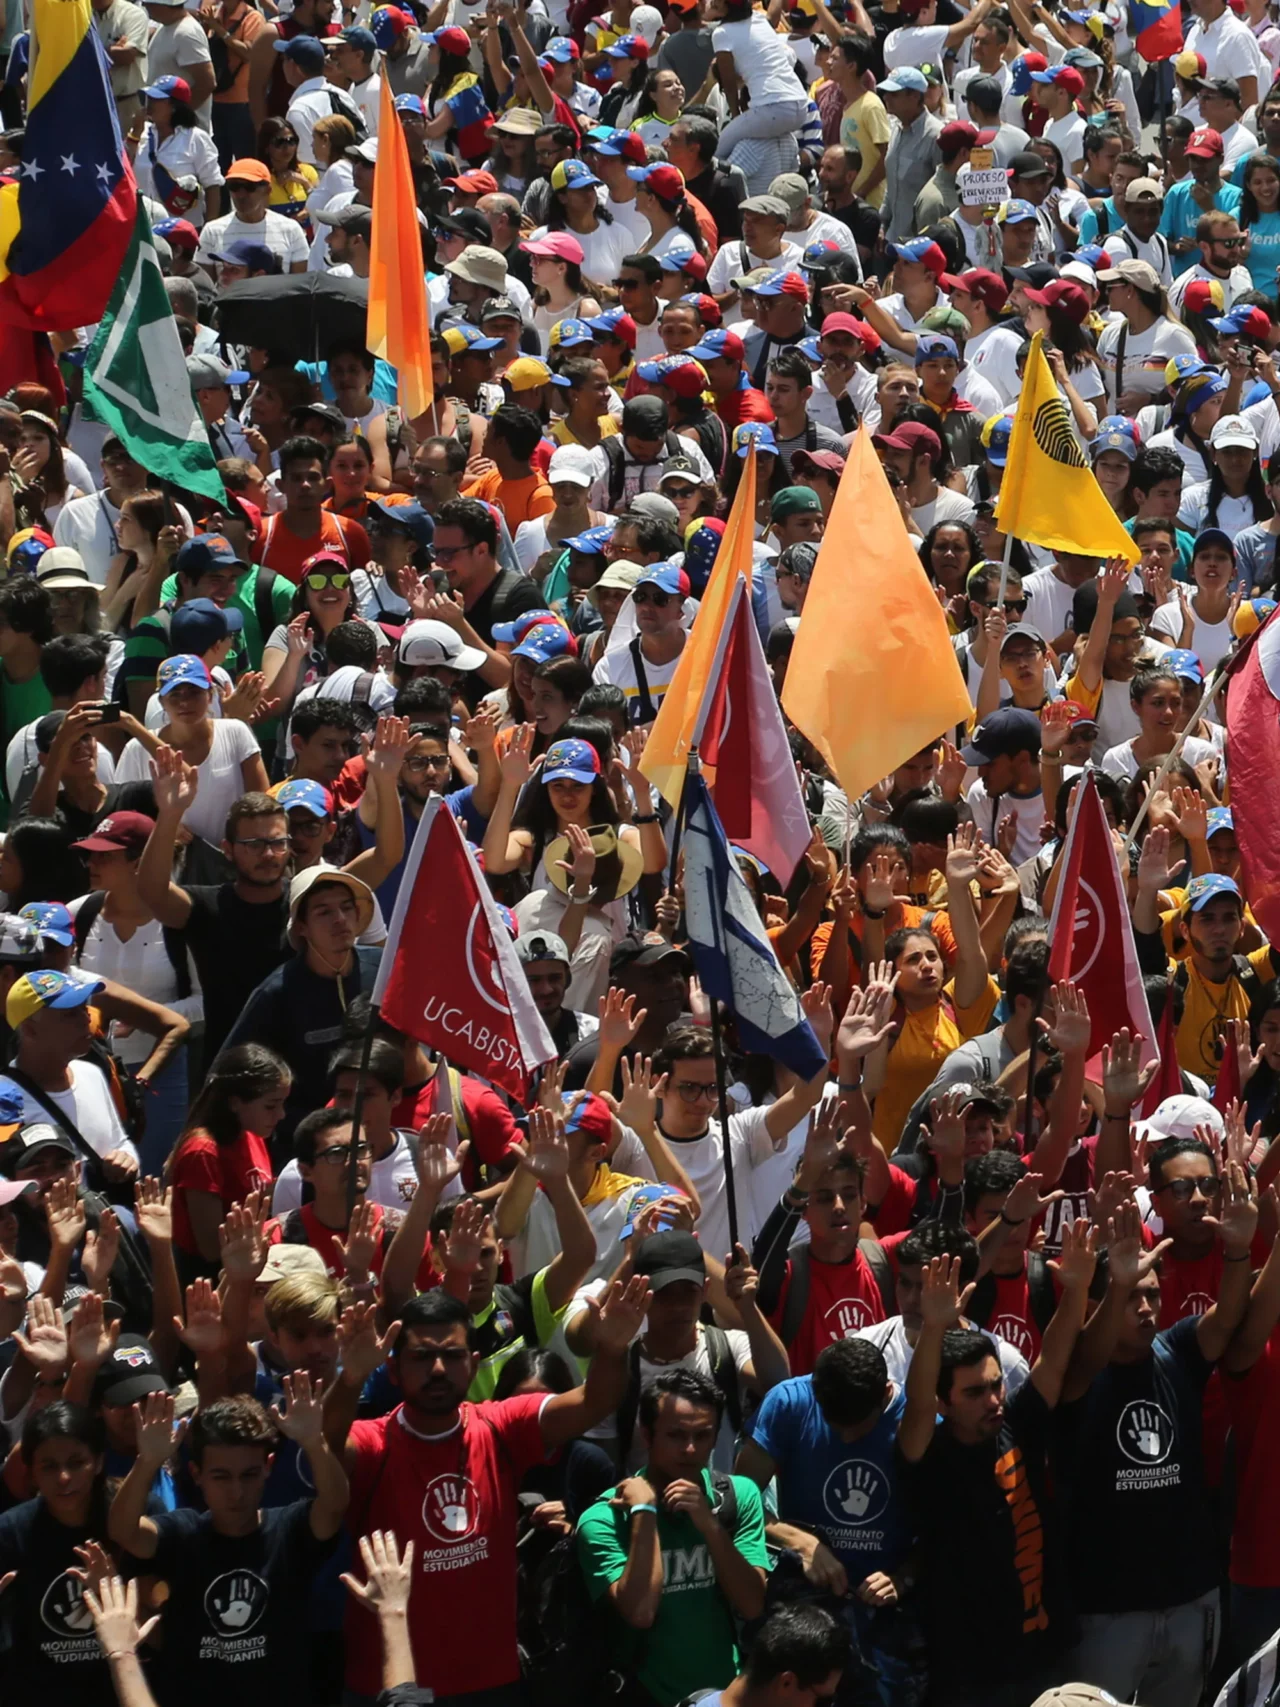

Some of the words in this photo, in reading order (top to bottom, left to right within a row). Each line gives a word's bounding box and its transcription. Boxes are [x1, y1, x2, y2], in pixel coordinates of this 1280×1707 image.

[963, 171, 1005, 186] PROCESO
[423, 995, 525, 1080] UCABISTA
[1116, 1463, 1181, 1479] MOVIMIENTO
[1115, 1475, 1181, 1490] ESTUDIANTIL
[820, 1524, 885, 1540] OVIMIENTO
[423, 1536, 488, 1559] MOVIMIENO
[831, 1538, 884, 1551] UDIANTIL
[423, 1549, 489, 1573] ESTUDIATIL
[40, 1638, 99, 1652] MOVIMIEN
[200, 1635, 267, 1650] MOMIENTO
[49, 1652, 104, 1664] TUDIAN
